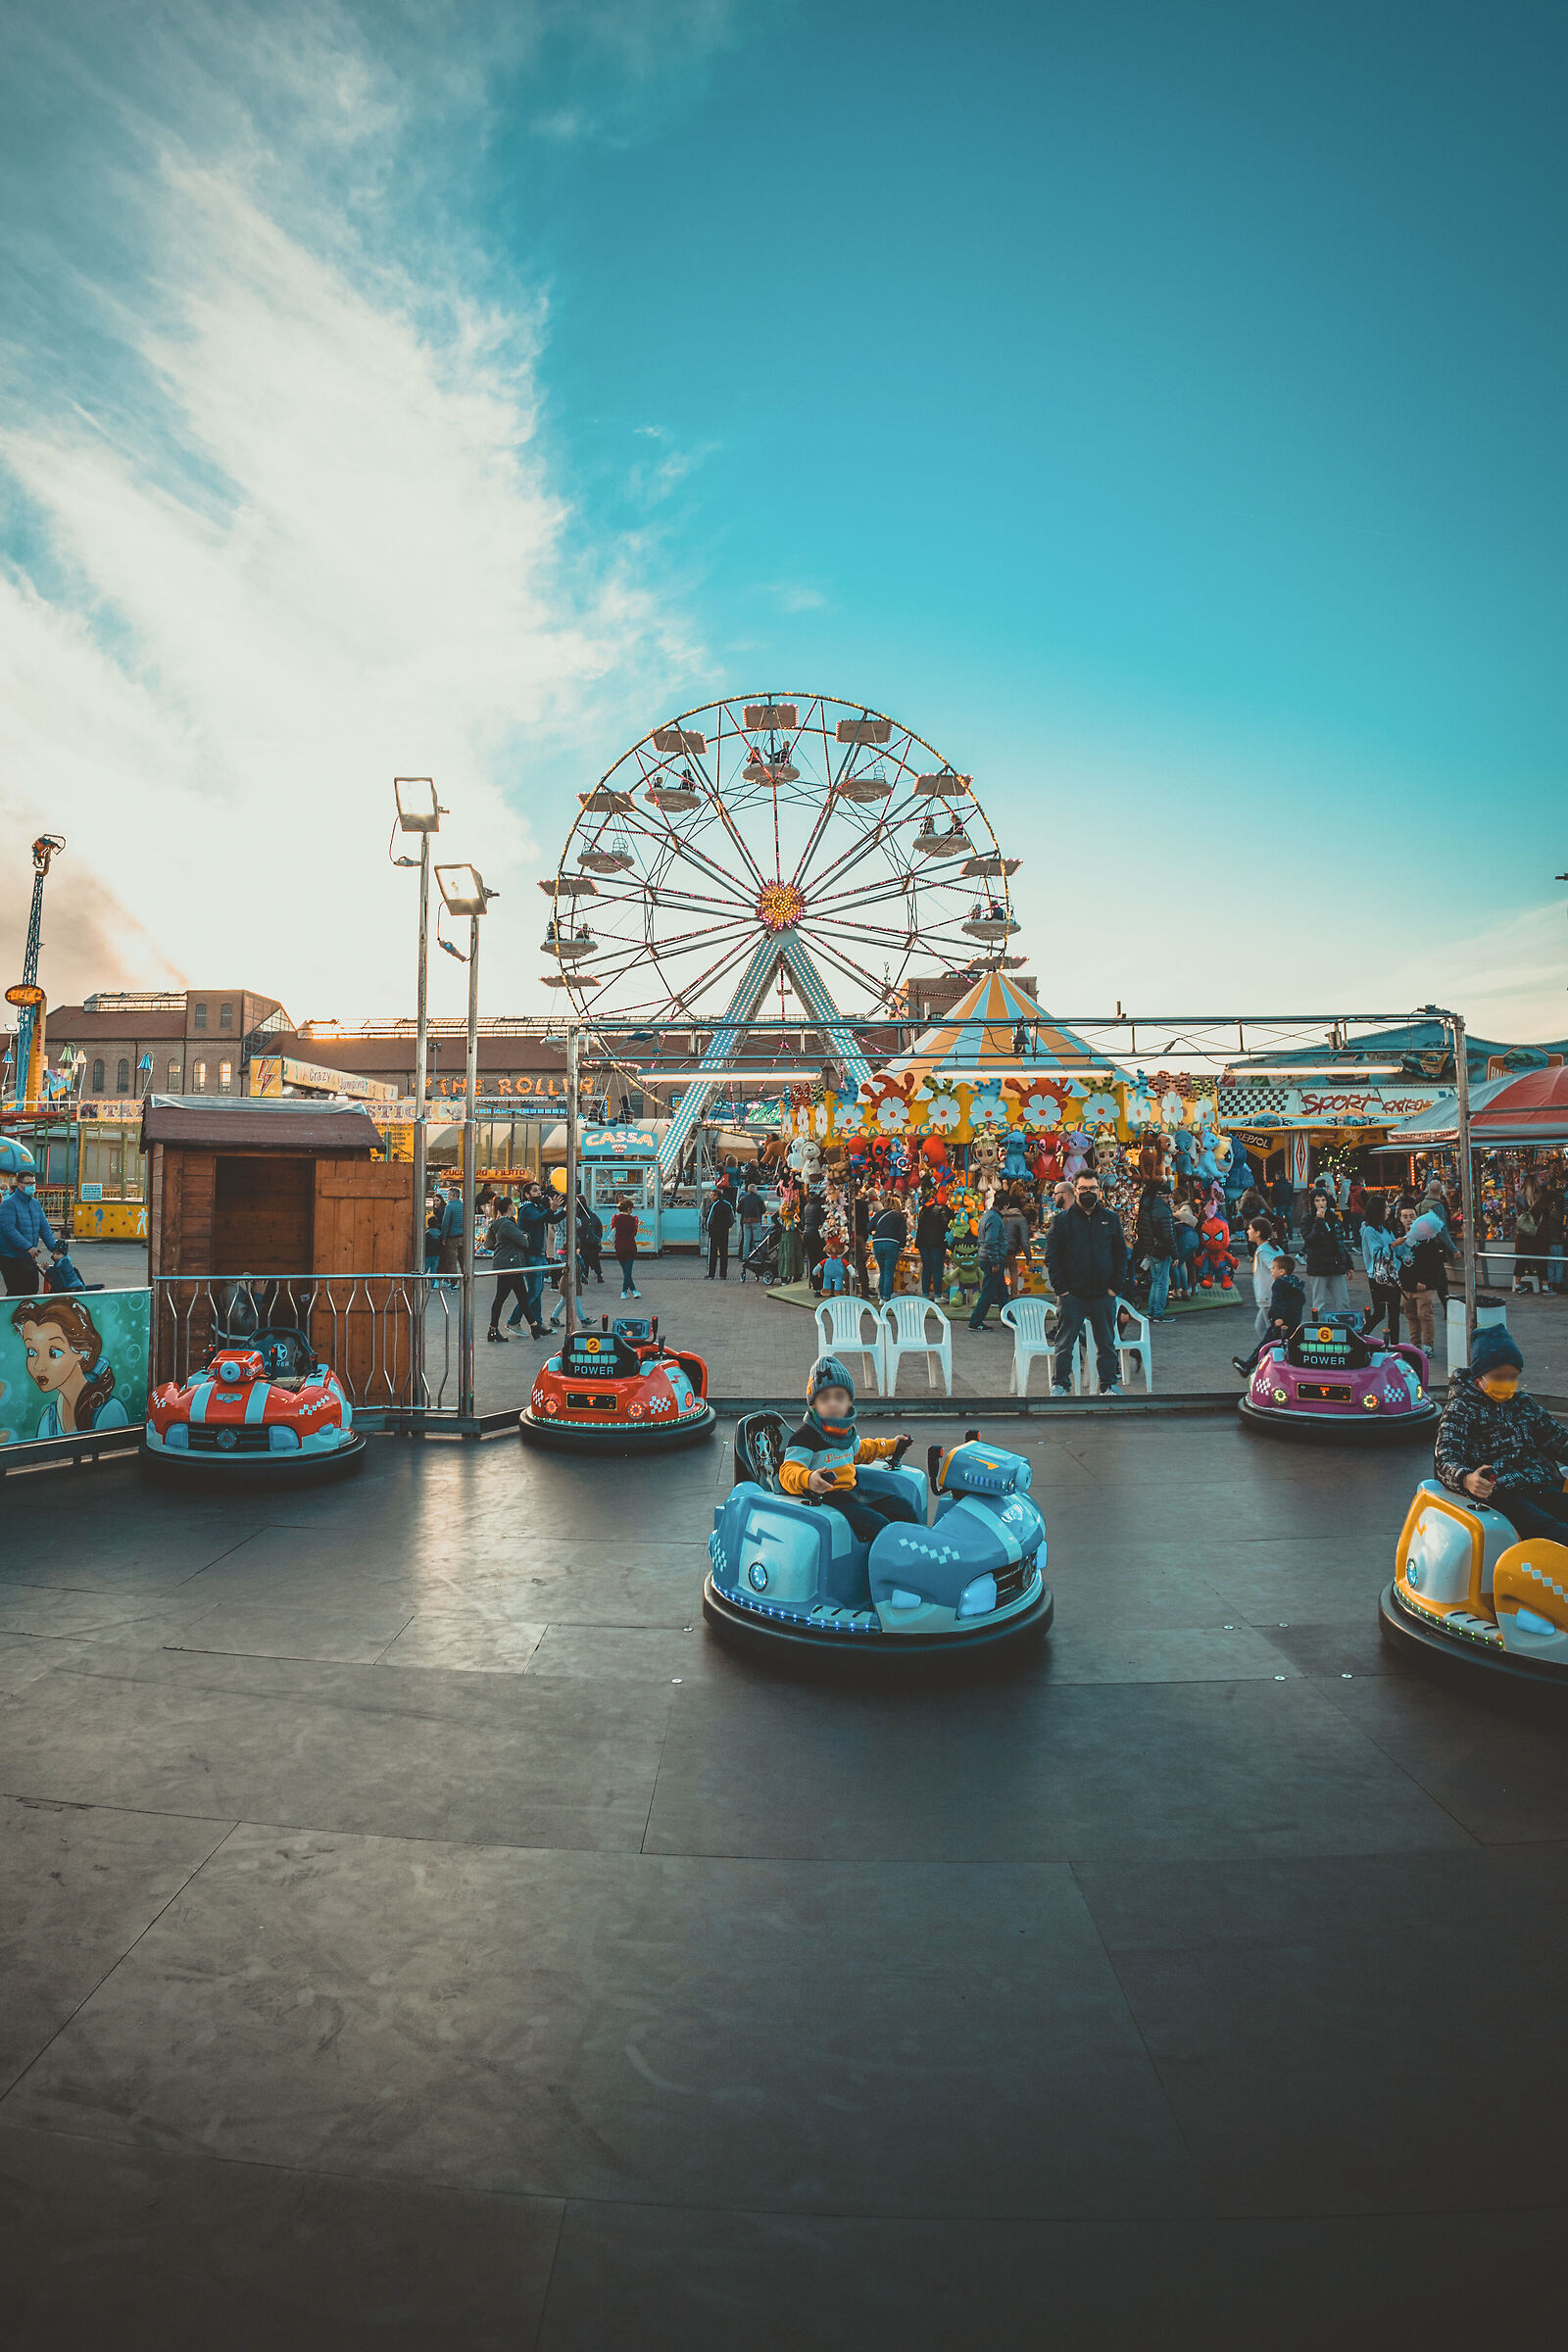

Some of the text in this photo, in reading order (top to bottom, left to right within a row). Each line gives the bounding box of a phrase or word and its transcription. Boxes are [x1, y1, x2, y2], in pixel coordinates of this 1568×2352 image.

[309, 1068, 366, 1092] Crazy Jumping
[1301, 1093, 1382, 1115] SPORT
[830, 1124, 879, 1139] PESCA
[902, 1122, 952, 1137] CIGNI
[975, 1120, 1036, 1137] PESCA
[1062, 1120, 1118, 1134] CIGNI
[585, 1131, 654, 1148] CASSA
[1235, 1131, 1269, 1149] REPSOL
[1320, 1330, 1330, 1340] 6
[589, 1341, 598, 1350] 2
[1302, 1354, 1346, 1365] POWER
[574, 1365, 613, 1375] POWER
